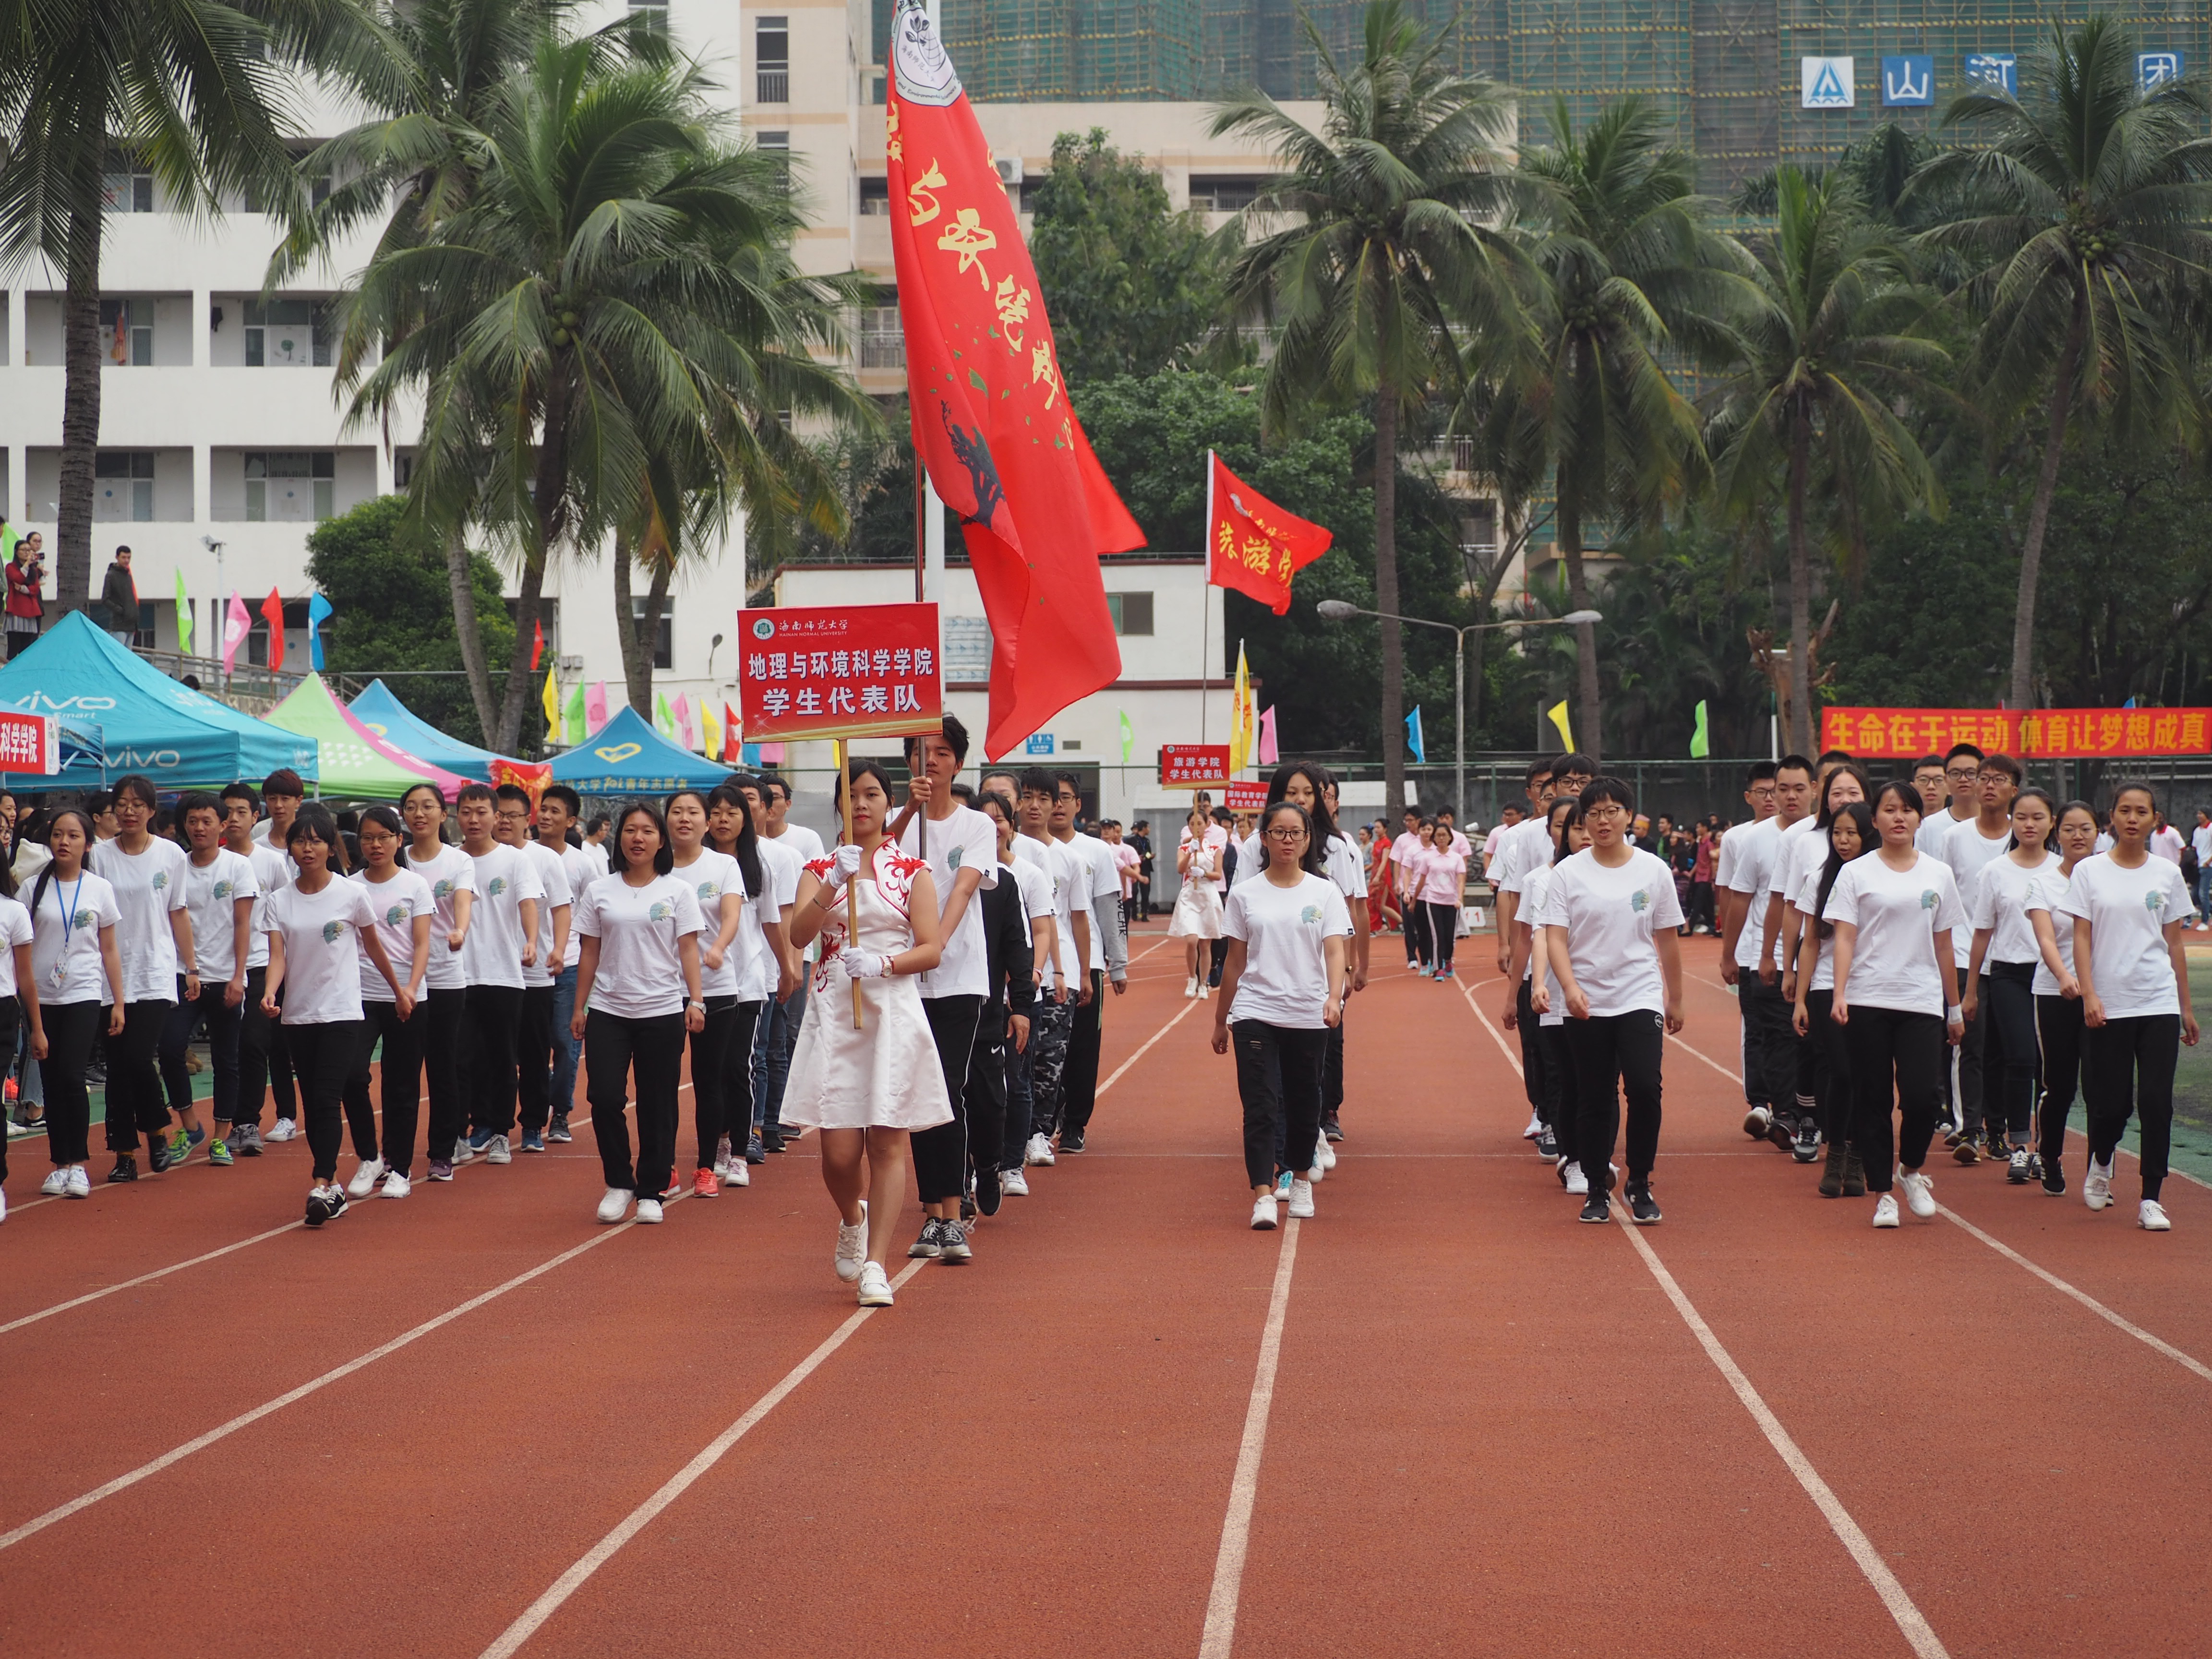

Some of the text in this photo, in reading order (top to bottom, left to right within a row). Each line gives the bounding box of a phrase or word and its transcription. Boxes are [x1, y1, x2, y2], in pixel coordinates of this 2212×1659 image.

[779, 619, 848, 631] 海南师范大学
[748, 647, 933, 681] 地理与环境科学学院
[762, 684, 922, 717] 学生代表队
[1828, 712, 2207, 753] 生命在于运动 体育让梦想成真
[103, 745, 180, 769] vivo
[1173, 757, 1220, 767] 旅游学院
[1169, 769, 1224, 780] 学生代表队
